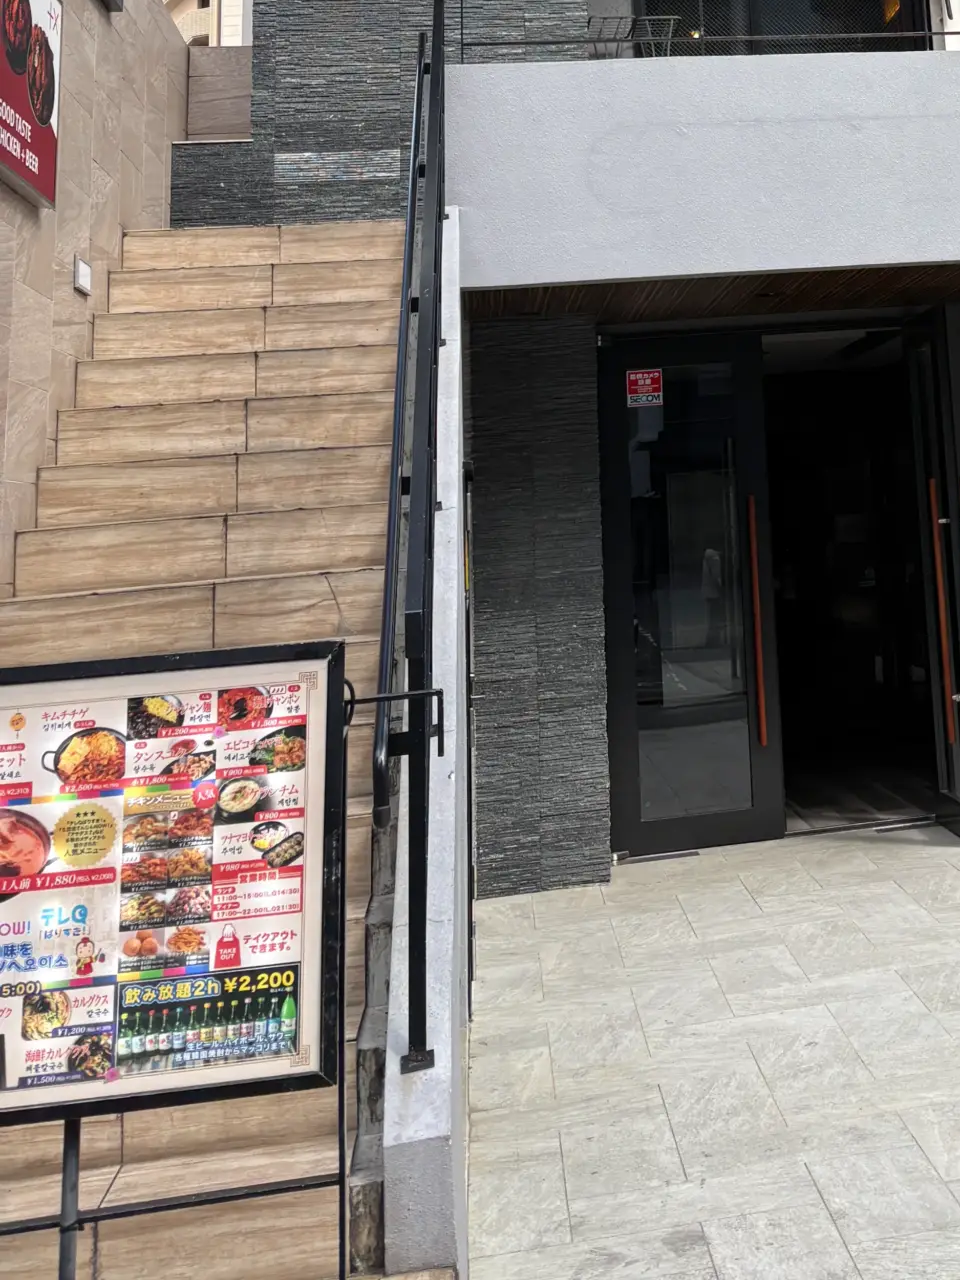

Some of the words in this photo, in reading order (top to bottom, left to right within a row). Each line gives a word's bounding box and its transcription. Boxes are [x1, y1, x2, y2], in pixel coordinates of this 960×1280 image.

[15, 112, 31, 143] TASTE
[25, 148, 39, 175] BEER
[630, 394, 661, 404] SECOM
[128, 793, 191, 807] チキンメニュー
[197, 791, 215, 803] 人気
[64, 848, 106, 857] 人気メニュー
[2, 879, 30, 891] 1人前
[36, 874, 76, 888] ¥1,880
[239, 871, 277, 884] 営業時間
[243, 930, 297, 943] テイクアウト
[249, 944, 291, 954] できます。
[224, 971, 295, 992] ¥2,200
[124, 980, 220, 1005] 飲み放題2h
[57, 1026, 86, 1036] ¥1,200
[27, 1075, 55, 1086] ¥1,500
